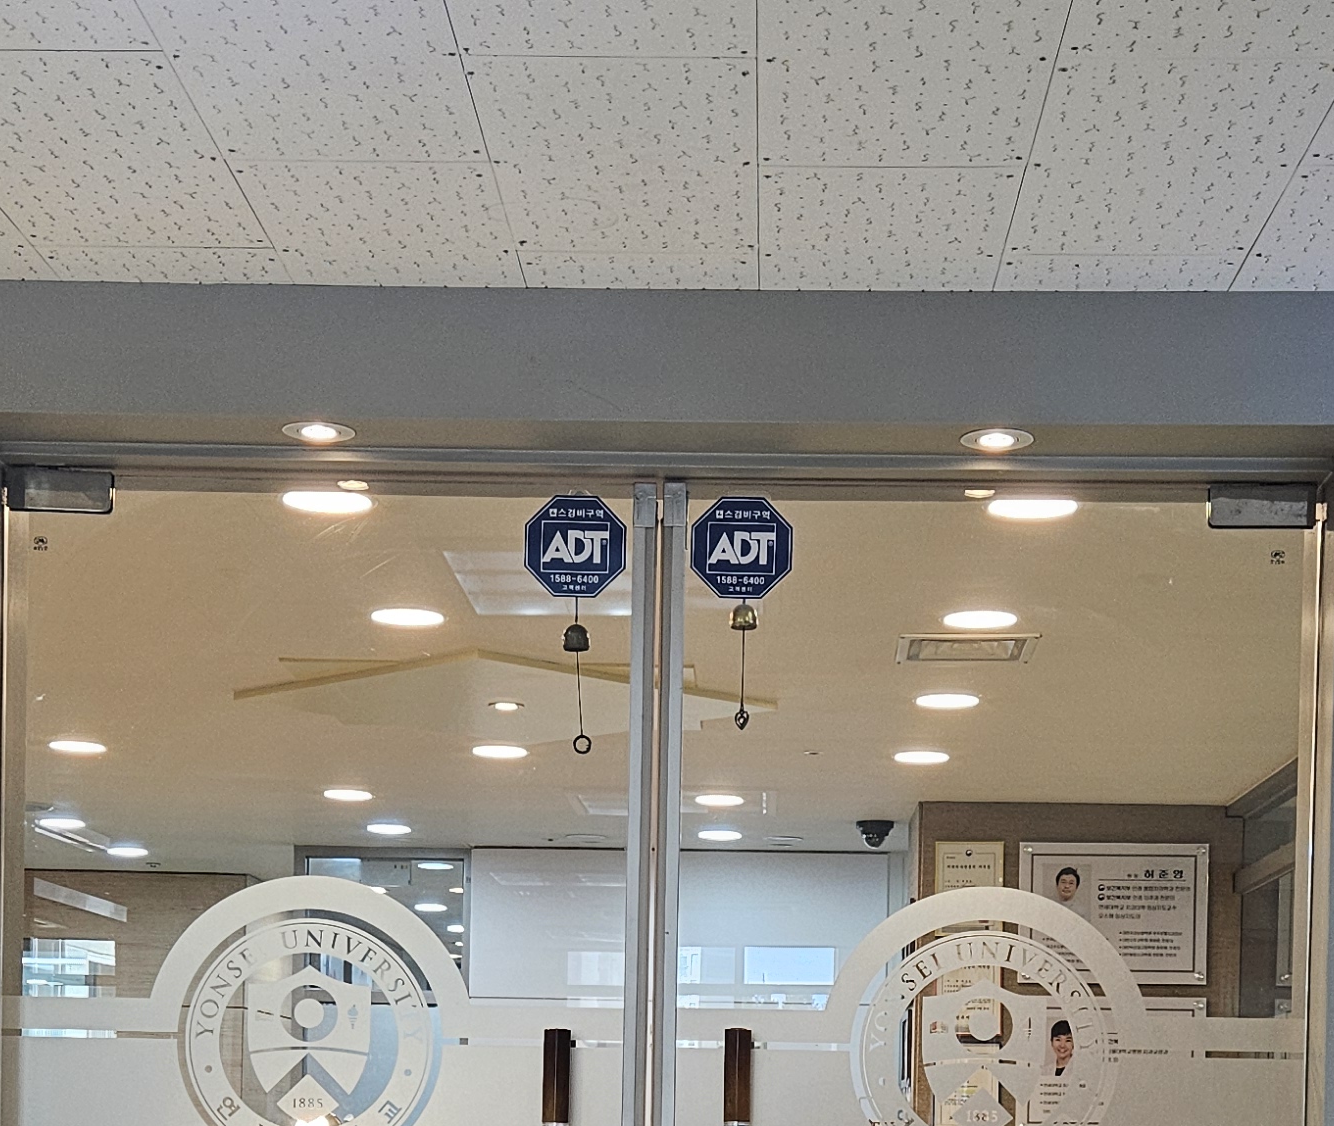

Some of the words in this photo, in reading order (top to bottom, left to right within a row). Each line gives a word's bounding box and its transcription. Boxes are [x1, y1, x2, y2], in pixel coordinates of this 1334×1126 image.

[542, 530, 609, 563] ADT
[708, 531, 776, 565] ADT
[550, 574, 599, 584] 1588-6400
[716, 576, 765, 585] 1588-6400
[291, 1097, 324, 1109] 1885
